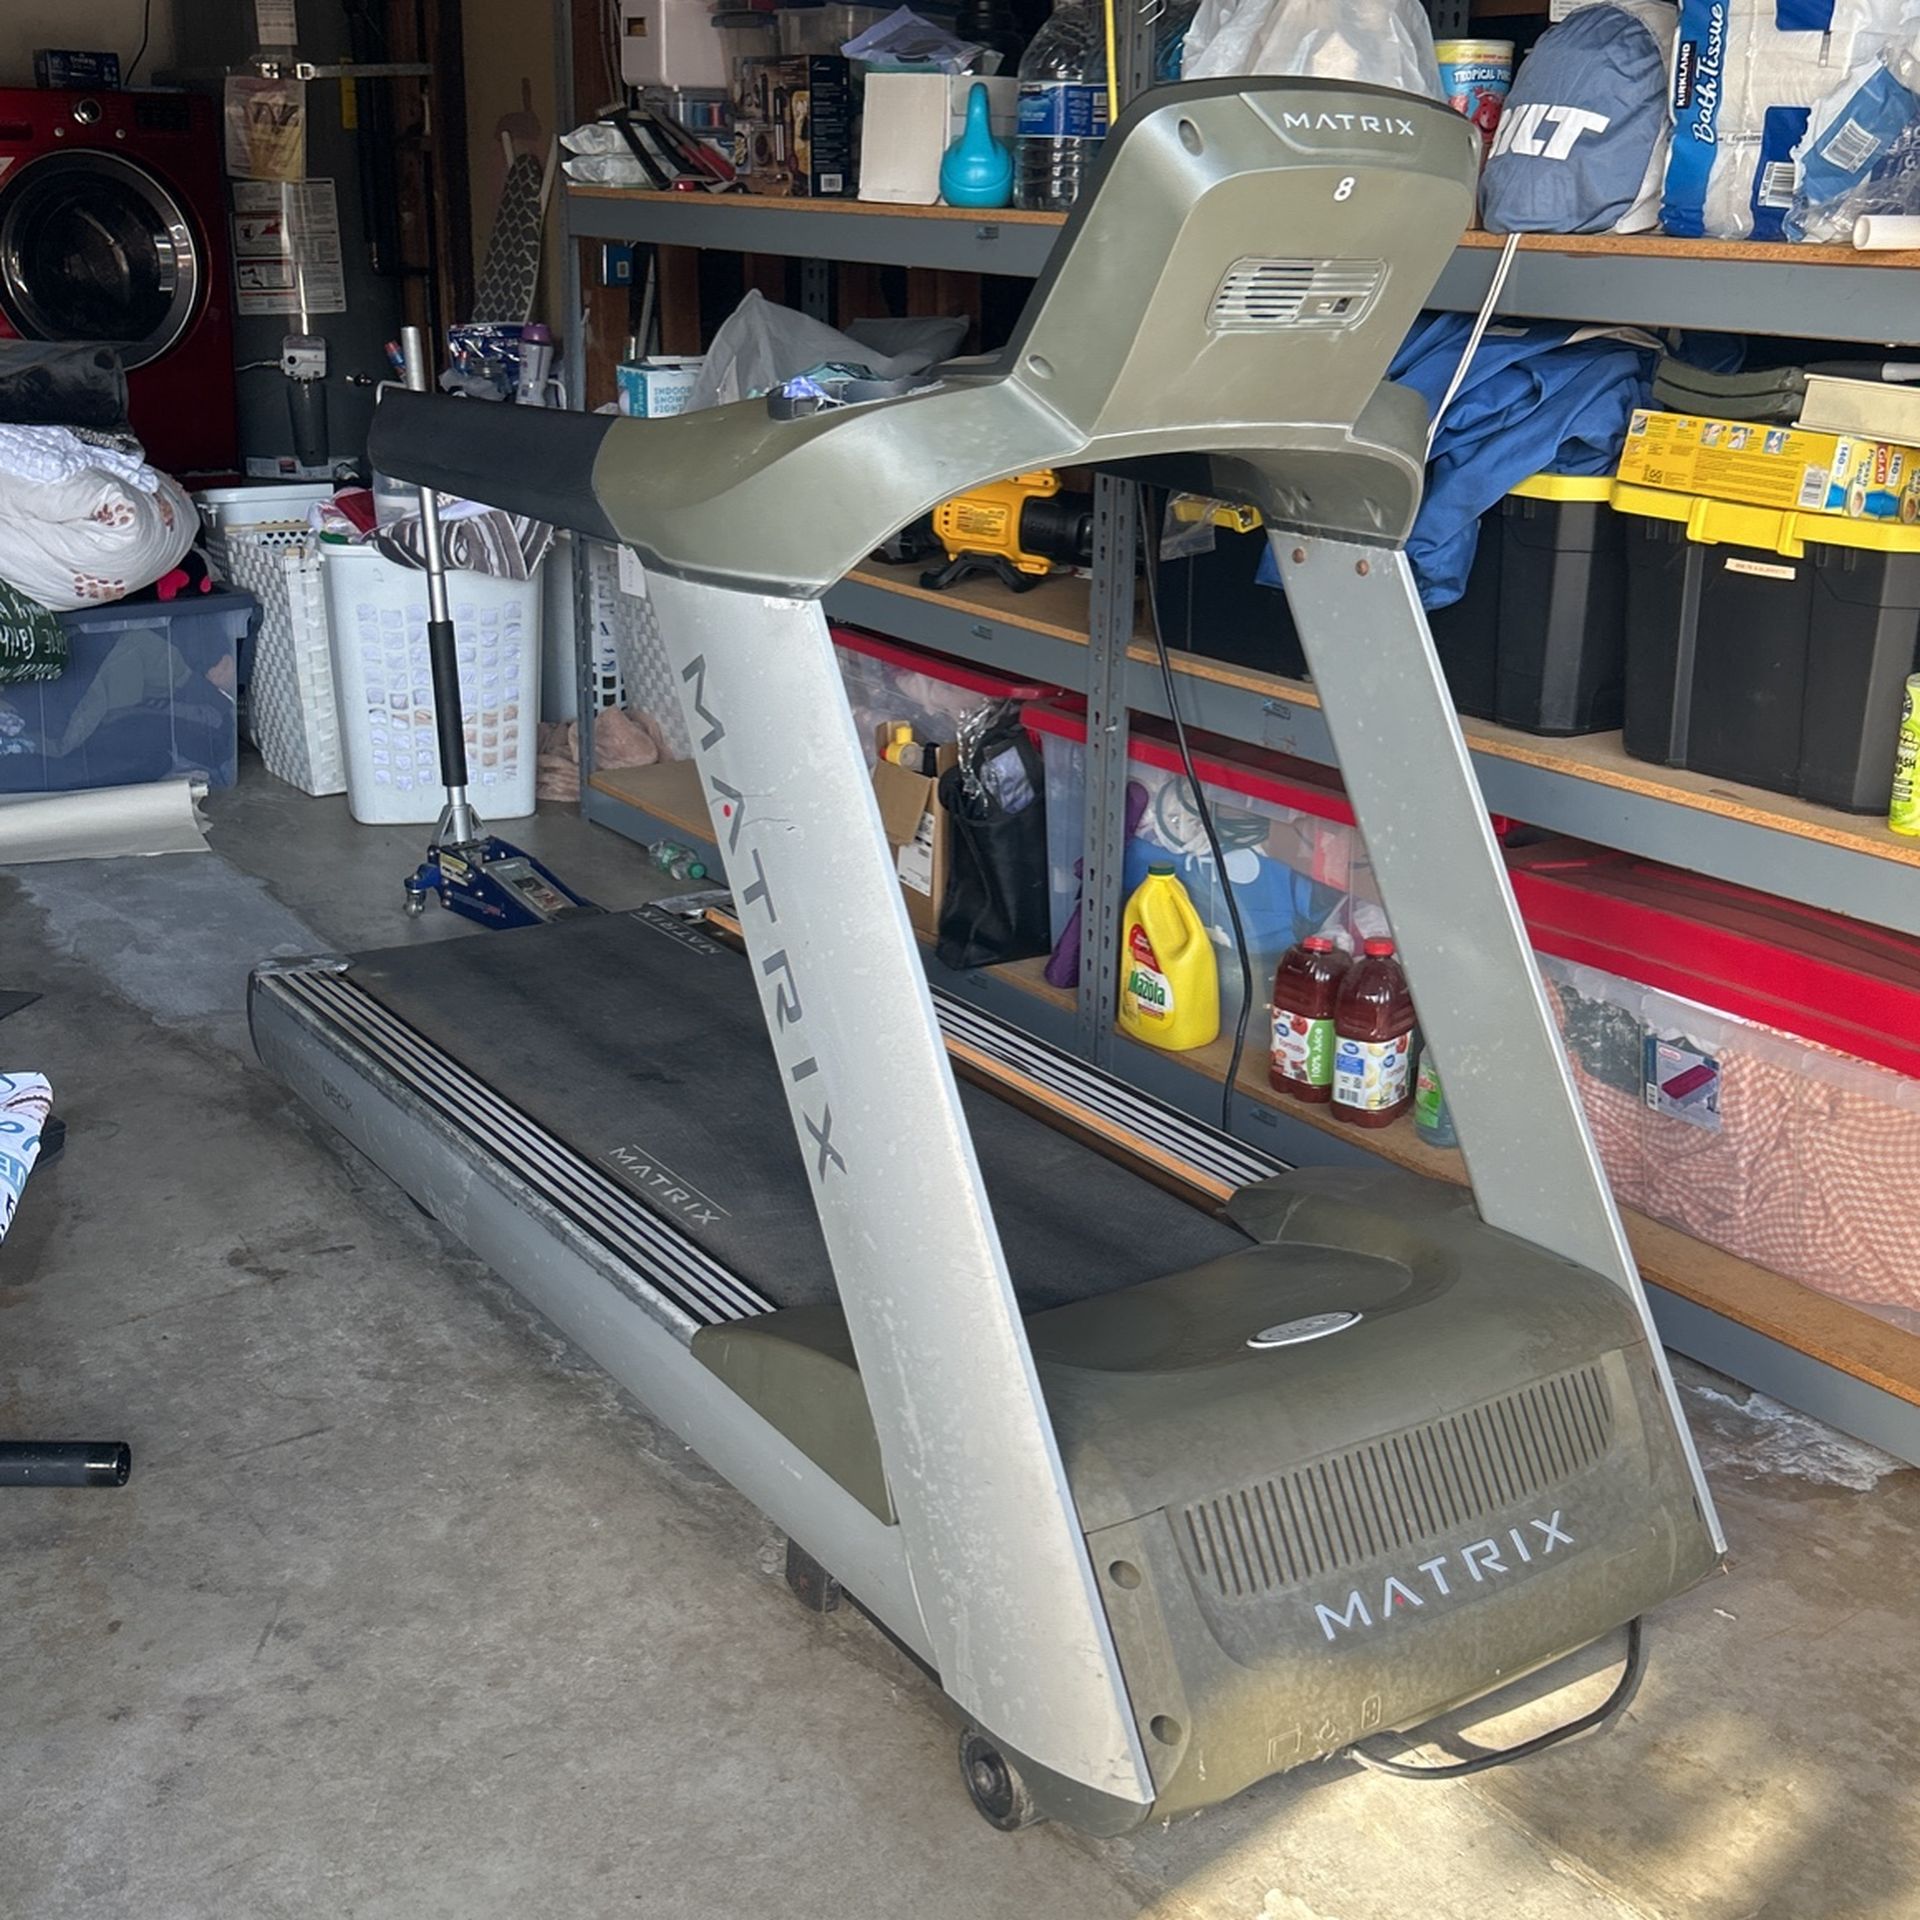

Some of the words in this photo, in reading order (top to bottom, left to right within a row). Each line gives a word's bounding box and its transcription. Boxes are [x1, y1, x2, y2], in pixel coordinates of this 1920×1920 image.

[1696, 3, 1724, 77] Tissue
[1454, 67, 1495, 82] TROPICAL
[1676, 43, 1691, 106] KIRKLAND
[1283, 112, 1414, 136] MATRIX
[1692, 78, 1718, 143] Bath
[1333, 176, 1355, 201] 8
[654, 386, 689, 396] INDOO
[1876, 447, 1887, 483] GLAD
[682, 654, 847, 1183] MATRIX
[1128, 970, 1165, 1006] Mazola
[1312, 1027, 1324, 1053] Juice
[1311, 1055, 1322, 1077] 100%
[608, 1147, 721, 1225] MATRIX
[1314, 1510, 1575, 1641] MATRIX
